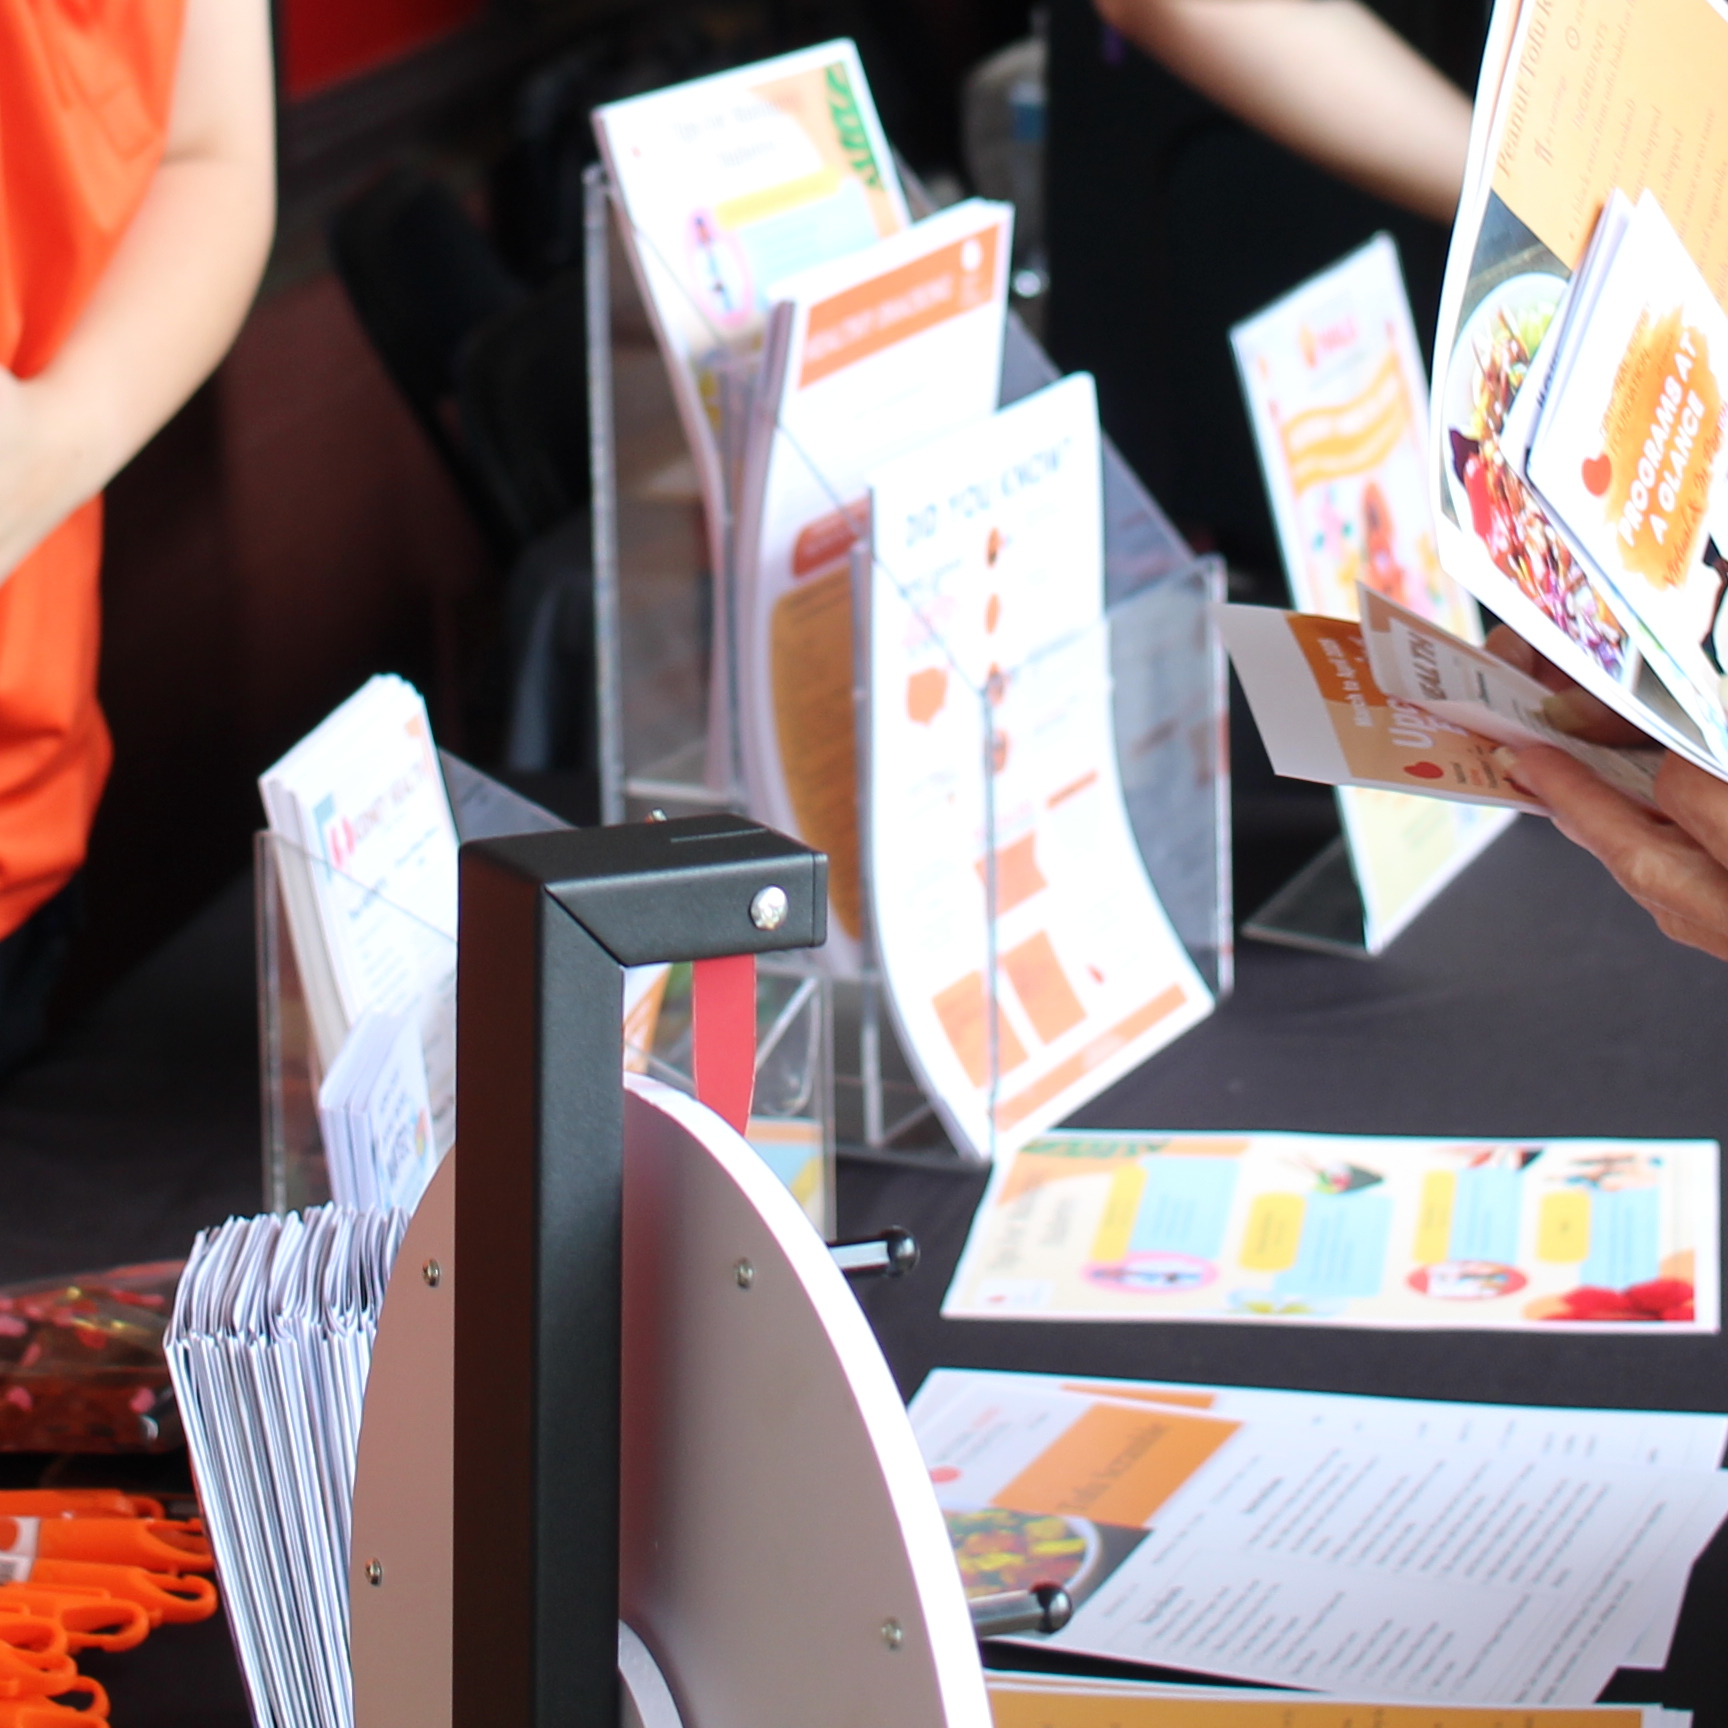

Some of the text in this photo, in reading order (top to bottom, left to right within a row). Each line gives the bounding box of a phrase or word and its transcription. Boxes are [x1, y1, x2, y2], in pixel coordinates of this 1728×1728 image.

[1573, 20, 1608, 129] INGREDIENTS
[1608, 25, 1628, 69] baked
[1496, 81, 1530, 175] Peanut
[1519, 17, 1546, 80] Tofu
[1591, 101, 1608, 133] firm
[1584, 134, 1601, 172] extra
[1637, 106, 1665, 169] chopped
[1658, 128, 1686, 190] chopped
[1571, 172, 1591, 213] block
[1617, 329, 1700, 549] PROGRAMS AT
[1645, 387, 1706, 545] A GLANCE
[1661, 508, 1694, 591] Virtual
